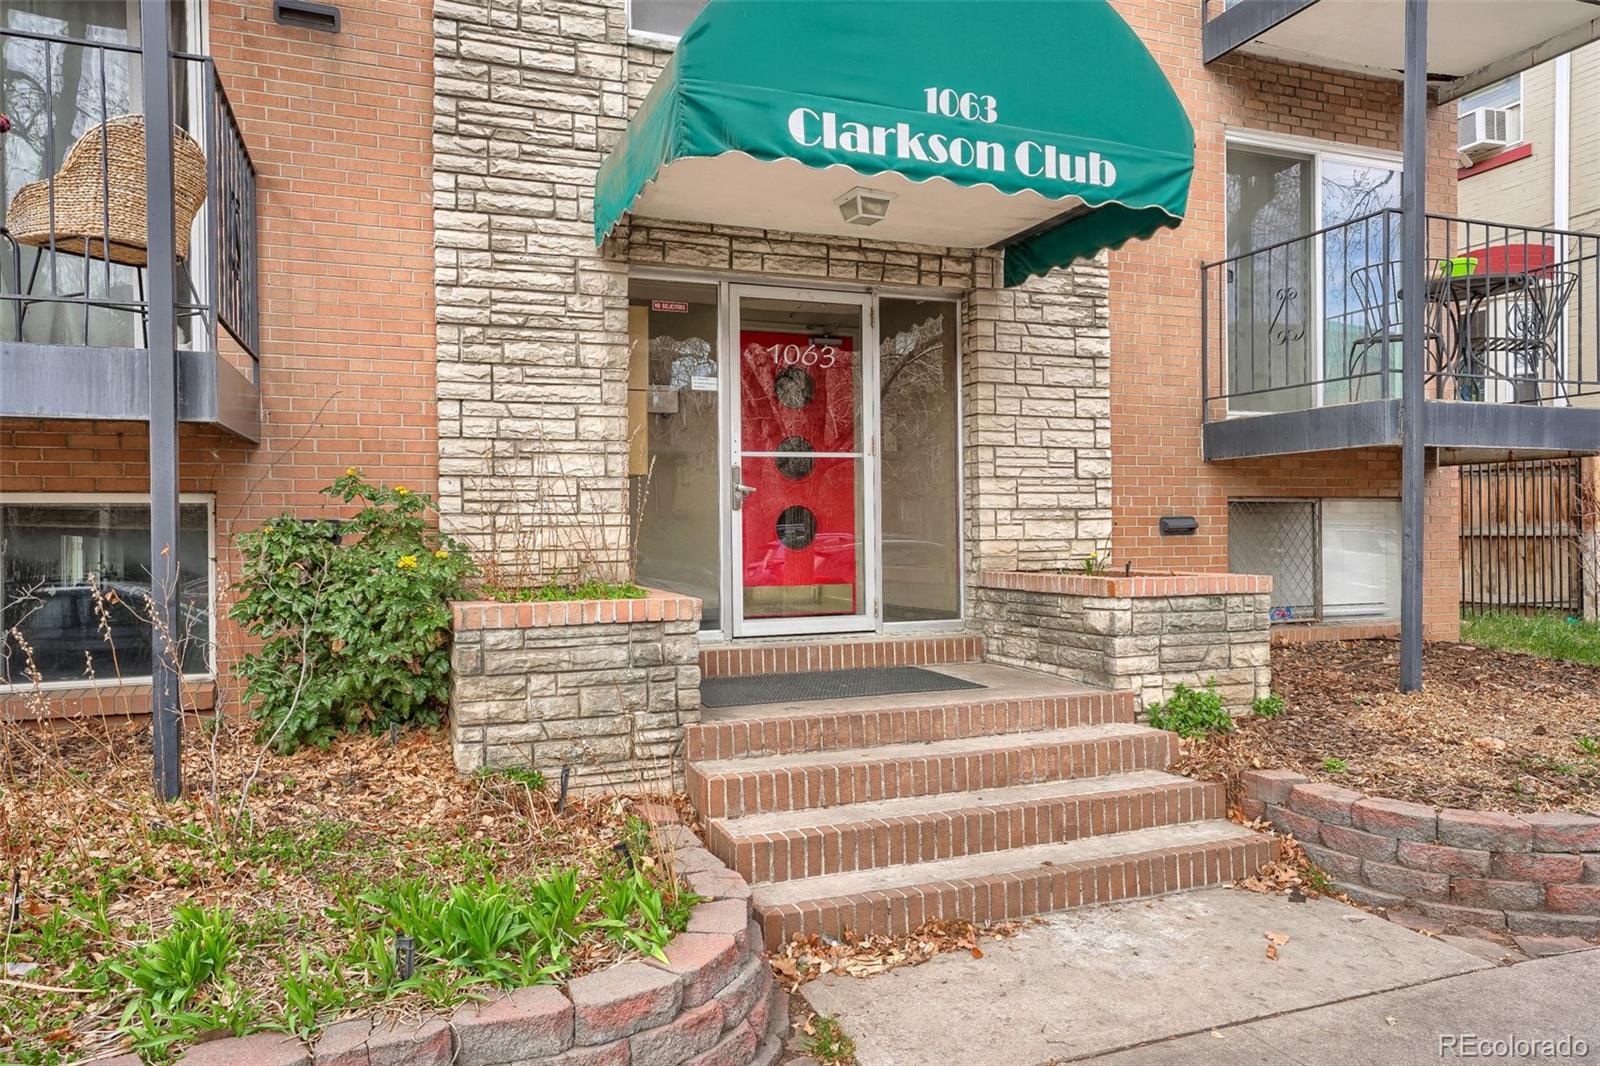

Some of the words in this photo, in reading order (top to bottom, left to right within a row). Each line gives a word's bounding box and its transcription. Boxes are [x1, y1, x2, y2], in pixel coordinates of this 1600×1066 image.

[923, 87, 998, 123] 1063
[788, 107, 1005, 172] Clarkson
[1015, 140, 1117, 187] Club
[766, 343, 836, 369] 1063
